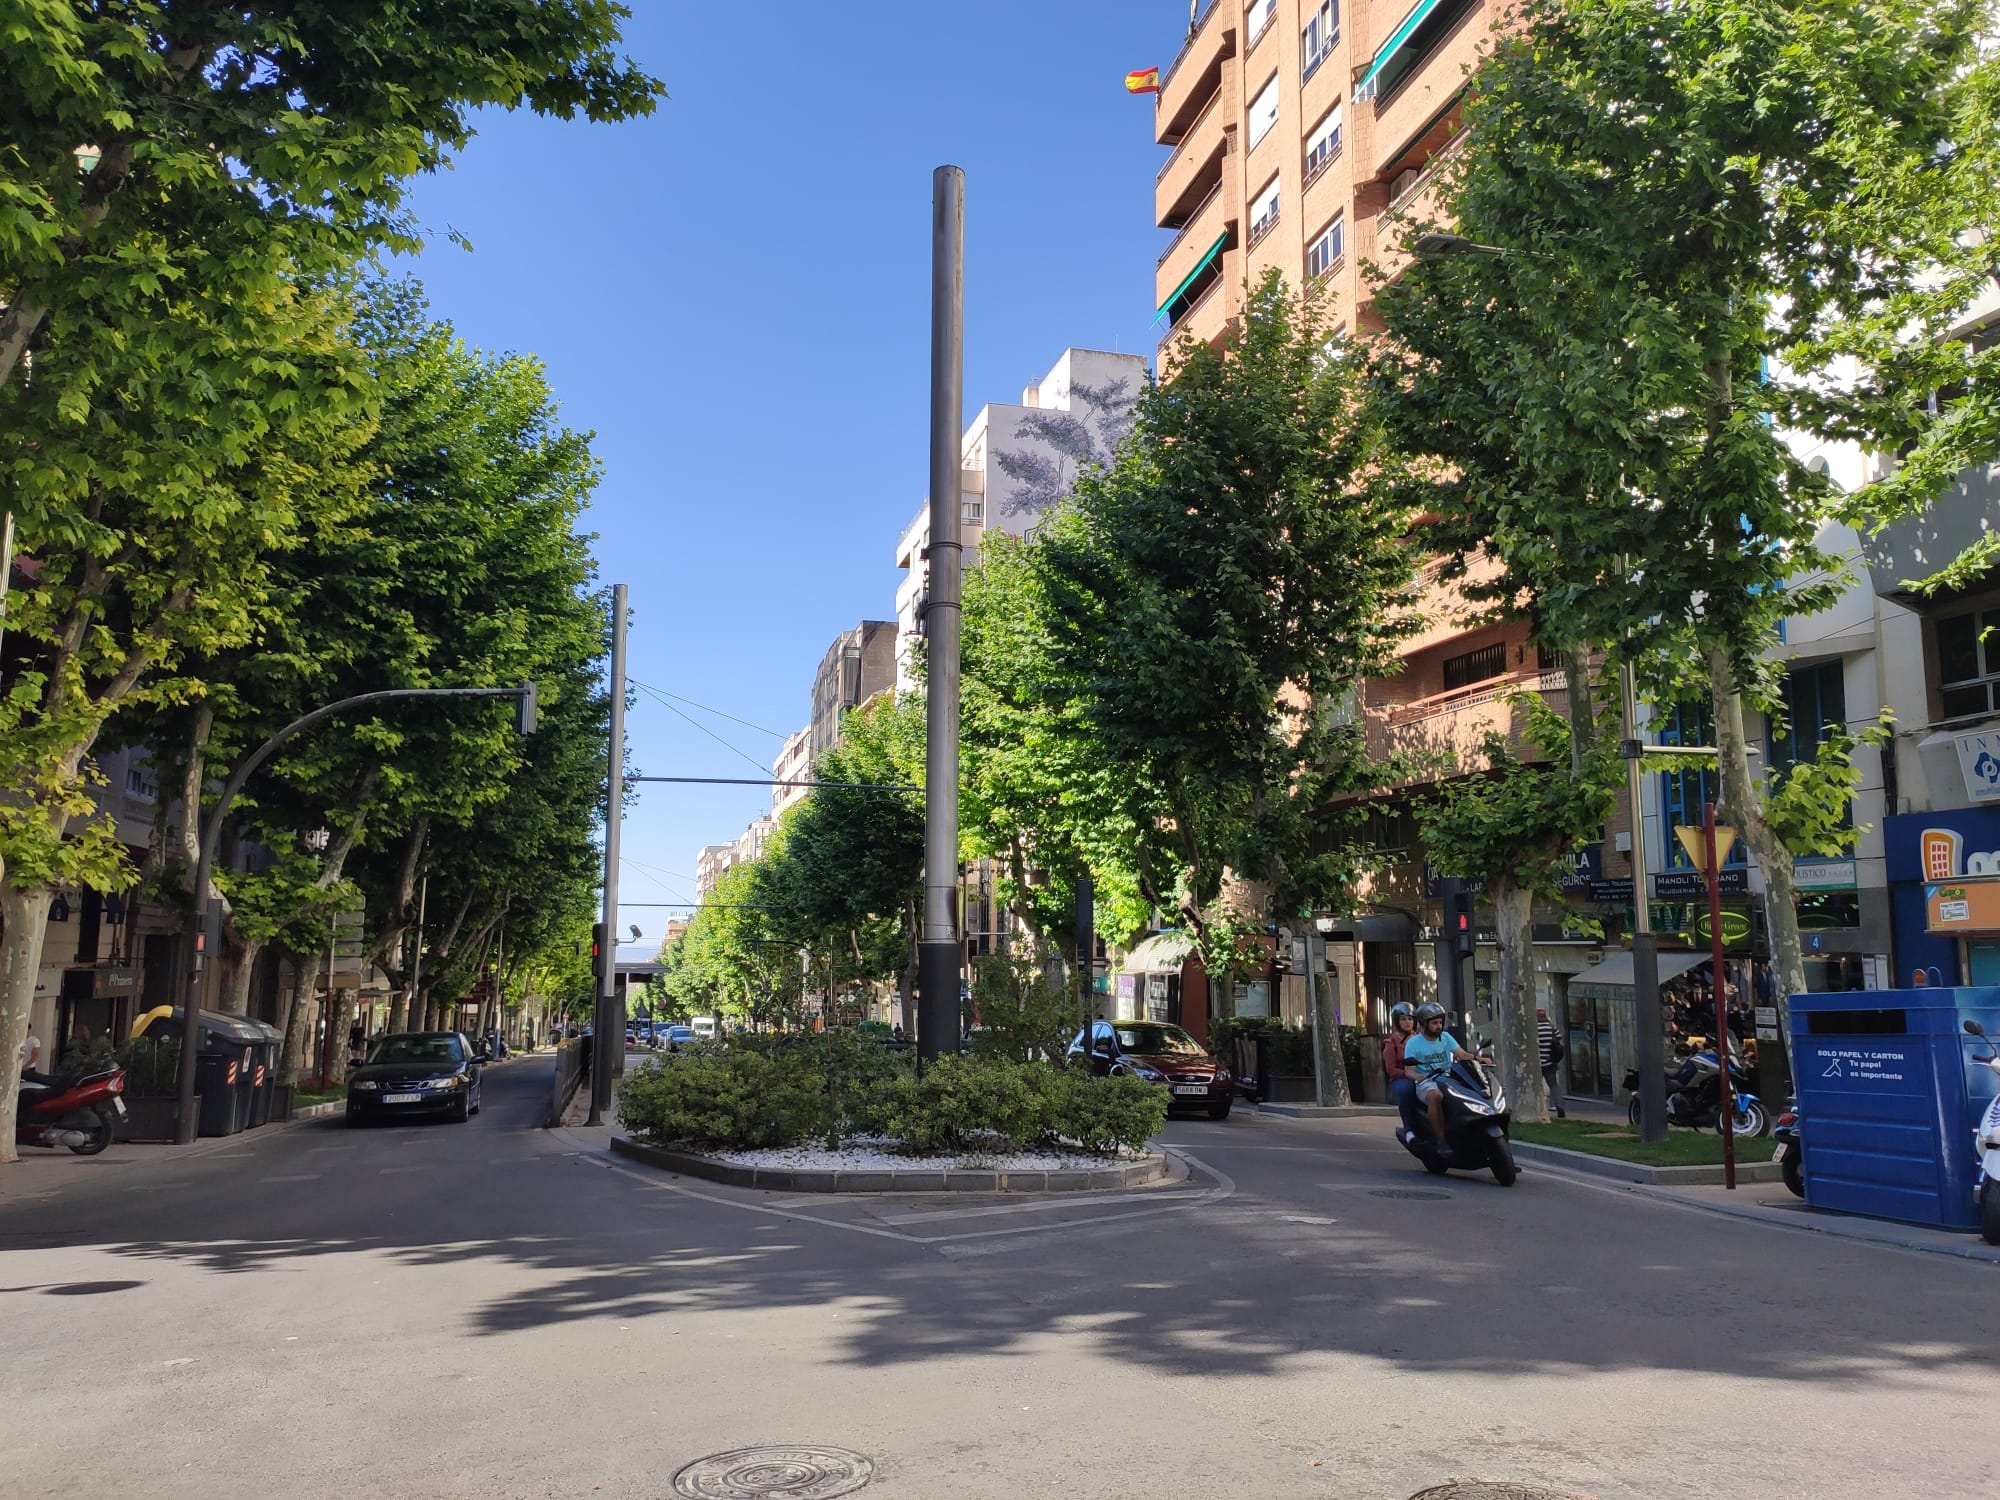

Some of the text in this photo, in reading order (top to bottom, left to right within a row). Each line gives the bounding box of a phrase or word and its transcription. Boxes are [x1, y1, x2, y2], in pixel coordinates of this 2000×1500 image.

[1812, 936, 1819, 949] 4
[1860, 1061, 1881, 1069] papel
[1860, 1071, 1903, 1080] importante
